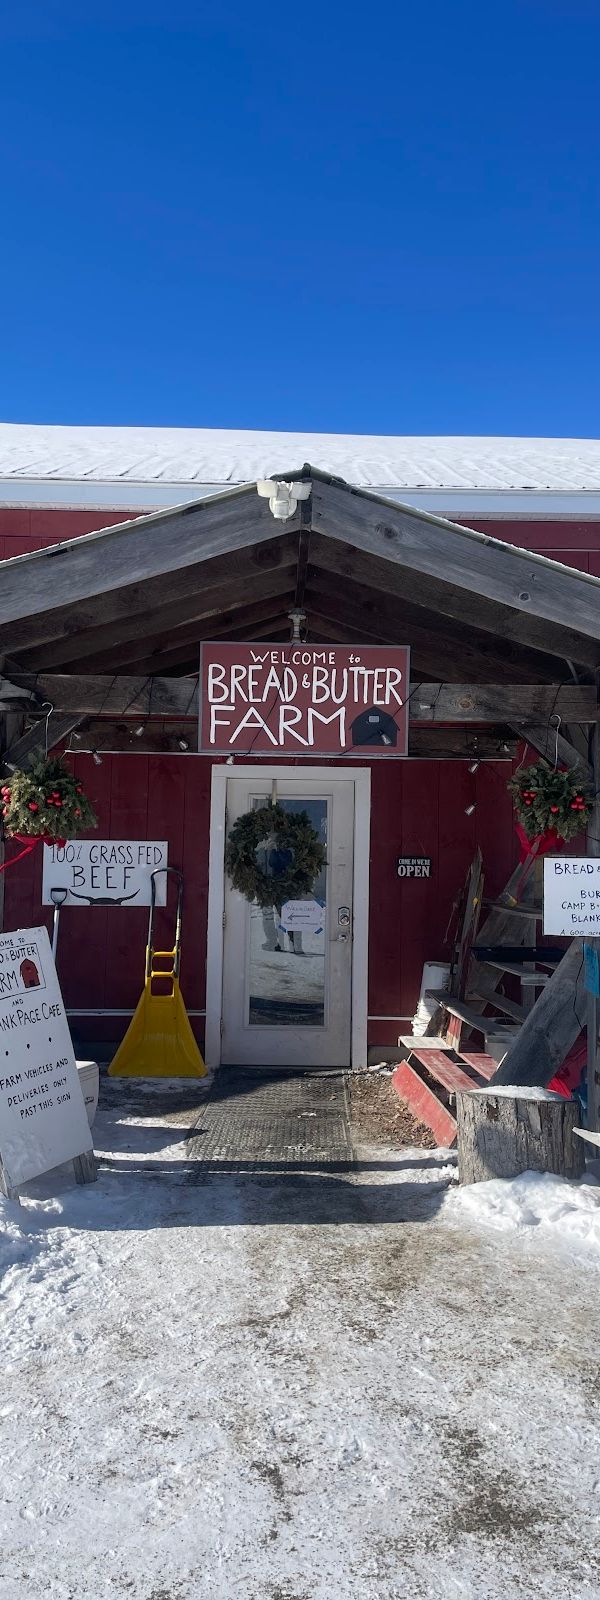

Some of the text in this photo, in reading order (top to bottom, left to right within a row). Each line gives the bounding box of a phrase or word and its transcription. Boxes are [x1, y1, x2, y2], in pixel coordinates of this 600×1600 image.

[250, 650, 361, 665] WELCOME to
[207, 663, 403, 706] BREAD & BUTTER
[209, 704, 346, 747] FARM
[50, 844, 163, 865] 100% GRASS FED
[71, 865, 135, 889] BEEF
[397, 865, 430, 877] OPEN
[554, 863, 594, 875] BREAD
[561, 901, 586, 910] CAMP
[10, 946, 37, 961] BUTTER
[12, 998, 24, 1007] AND
[17, 1009, 41, 1026] PAGE
[41, 1002, 62, 1020] CAFE
[0, 1058, 69, 1090] FARM VEHICLES AND
[7, 1077, 67, 1107] DELIVERIES ONLY
[20, 1092, 71, 1119] PAST THIS SIGN
